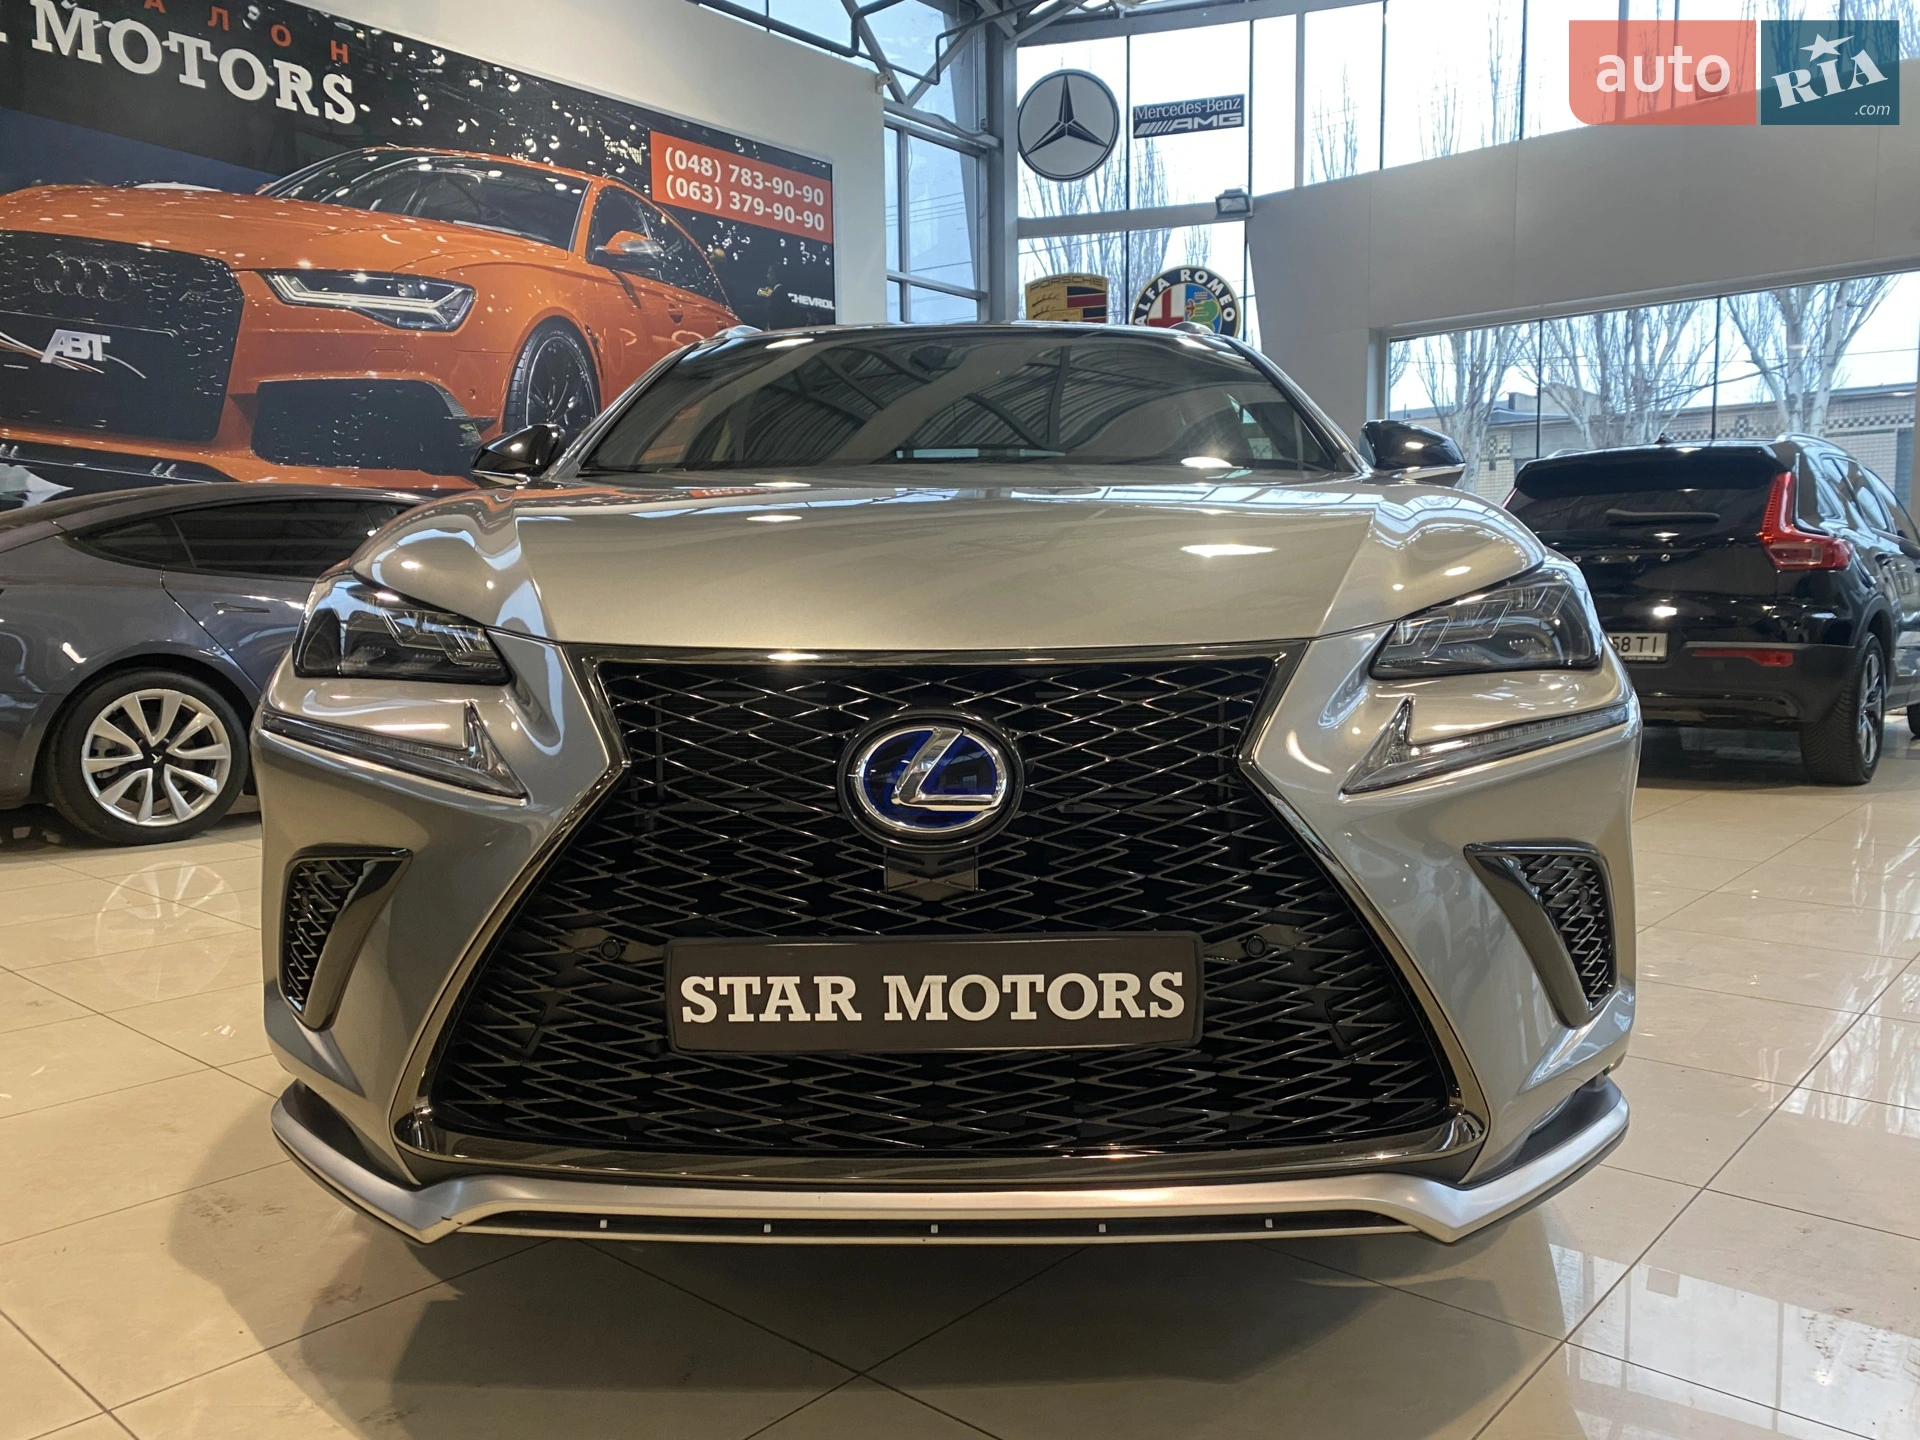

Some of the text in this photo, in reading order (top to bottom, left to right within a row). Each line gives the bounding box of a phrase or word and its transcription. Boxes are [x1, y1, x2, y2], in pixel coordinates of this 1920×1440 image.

[30, 0, 356, 124] MOTORS
[1134, 98, 1241, 121] Mercedes-Benz
[665, 146, 824, 206] (048) 783-90-90
[666, 174, 825, 231] (063) 379-90-90
[1029, 275, 1103, 293] PORSCHE
[1134, 269, 1236, 326] ALFA ROMEO
[40, 329, 111, 363] ABT
[681, 971, 1185, 1022] STAR MOTORS
